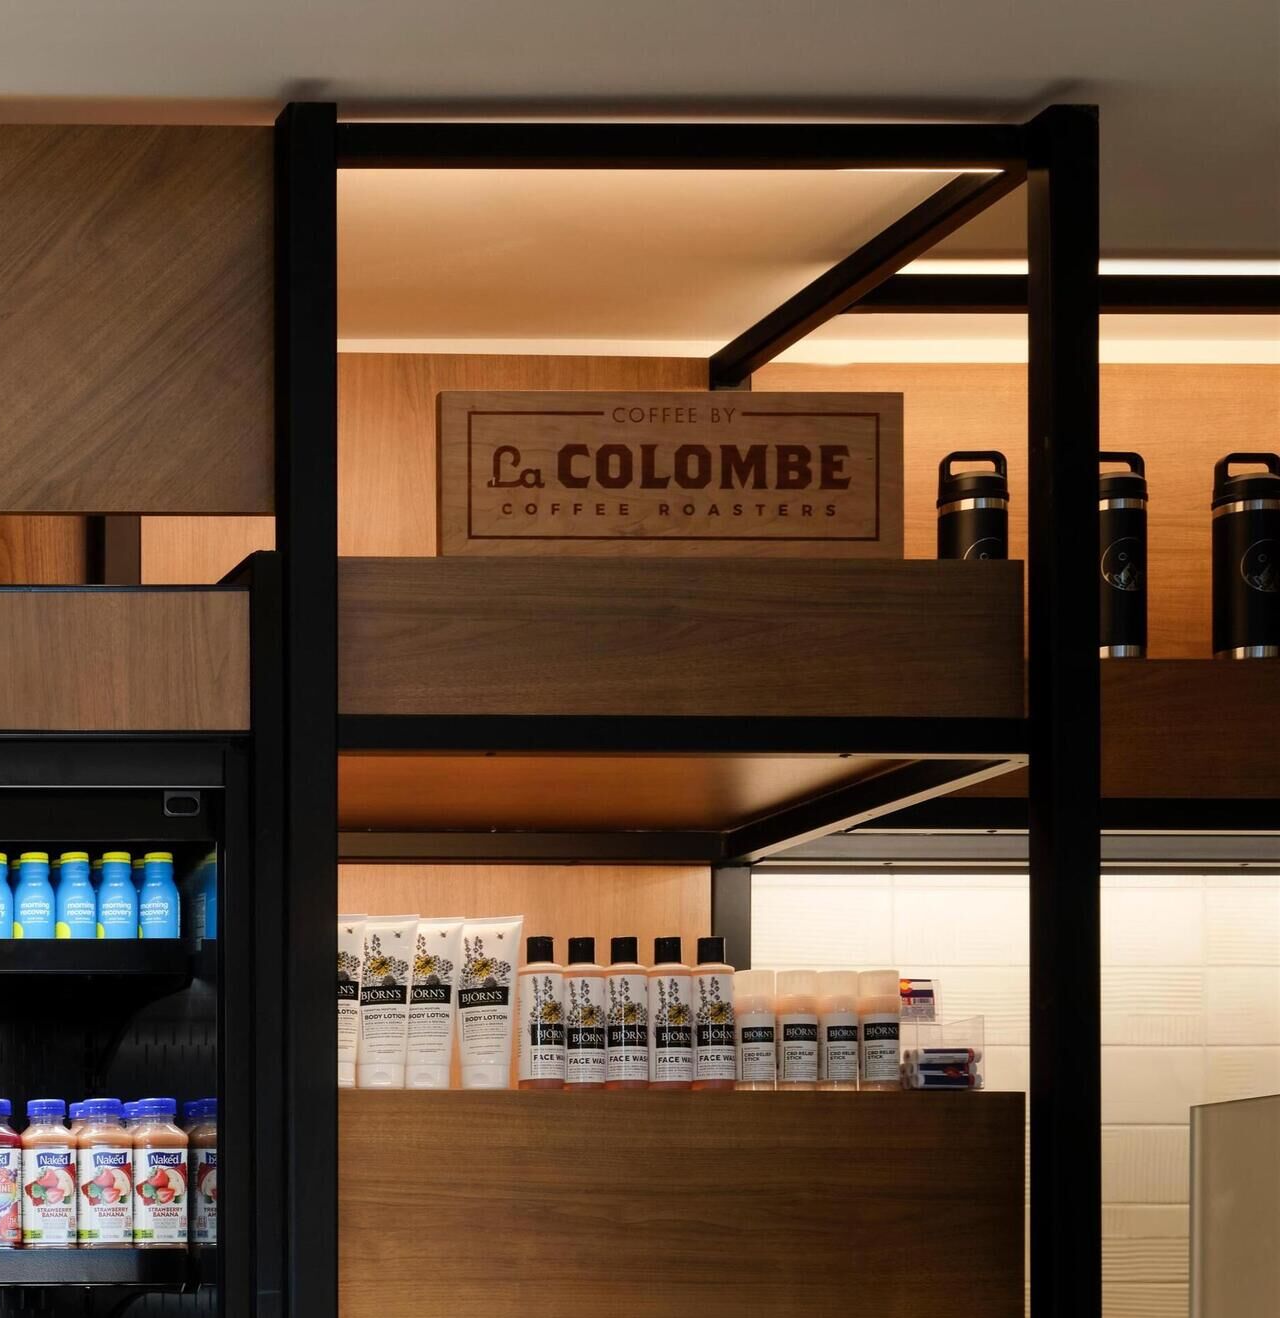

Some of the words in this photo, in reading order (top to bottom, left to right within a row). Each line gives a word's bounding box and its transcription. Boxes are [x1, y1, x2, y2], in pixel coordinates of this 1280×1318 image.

[612, 407, 698, 424] COFFEE
[711, 408, 737, 424] BY
[487, 445, 545, 488] La
[558, 444, 852, 490] COLOMBE
[502, 503, 630, 516] COFFEE
[659, 504, 836, 517] ROASTERS
[361, 988, 401, 1001] BJÖRN'S
[461, 990, 502, 1002] BJÖRN'S
[40, 1154, 68, 1166] Naked
